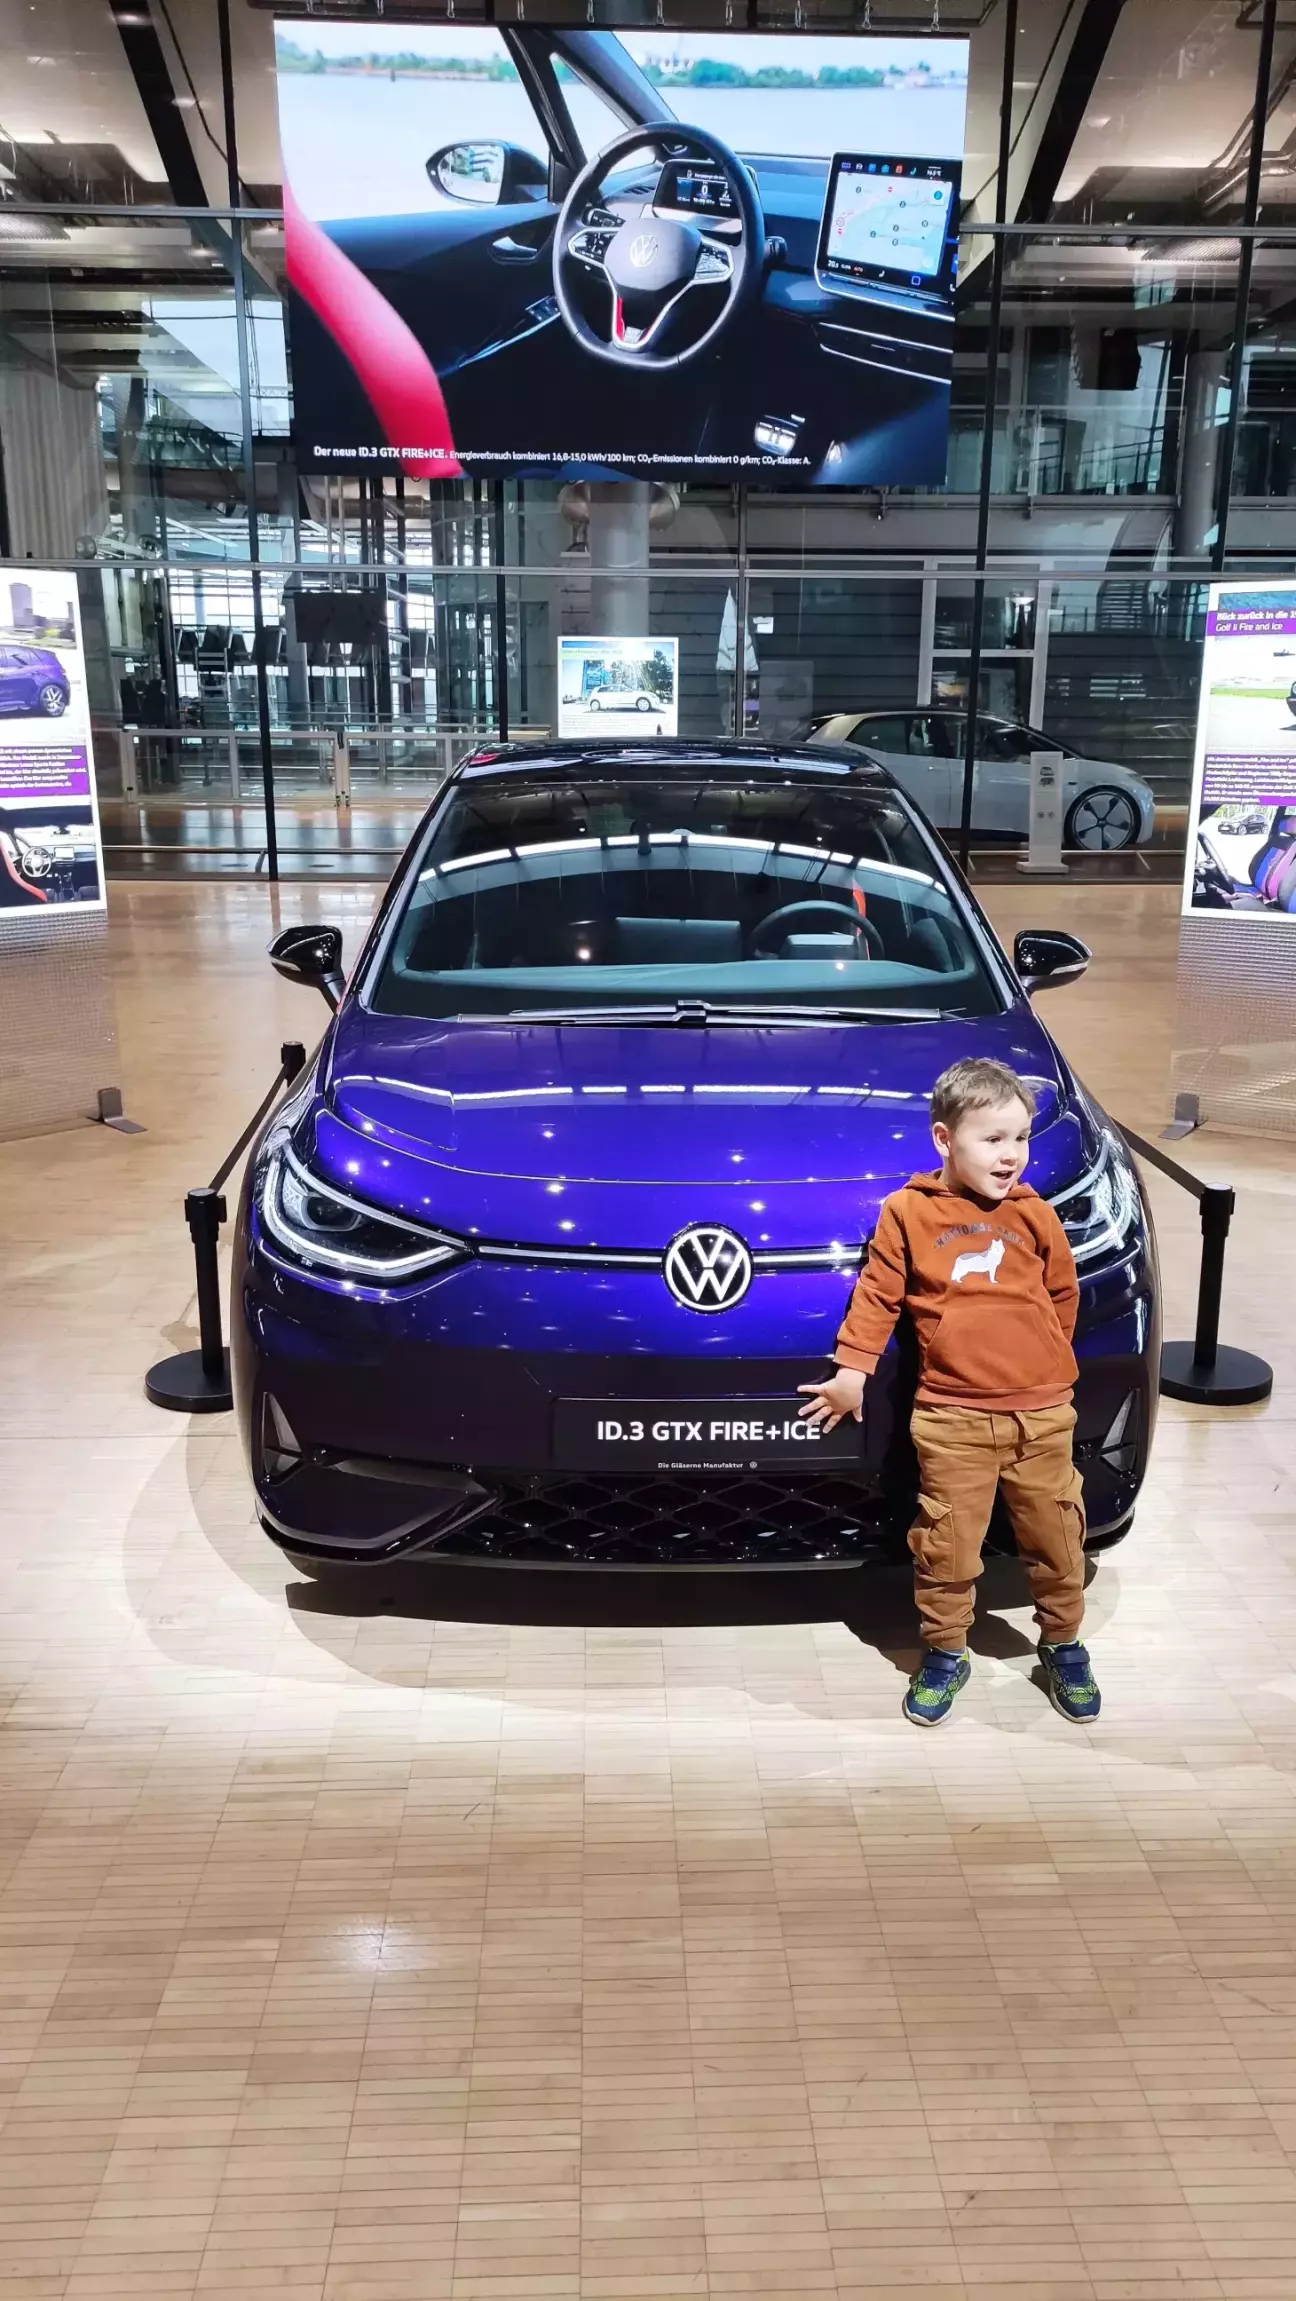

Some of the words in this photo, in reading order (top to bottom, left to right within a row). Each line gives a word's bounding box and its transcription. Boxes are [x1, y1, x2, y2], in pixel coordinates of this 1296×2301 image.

[314, 446, 331, 457] Der
[332, 447, 356, 457] neue
[358, 447, 378, 458] ID.3
[379, 447, 400, 458] GTX
[450, 451, 511, 461] Energieverbrauch
[513, 451, 551, 461] kombiniert
[694, 454, 732, 464] kombiniert
[1217, 612, 1236, 621] Blick
[1275, 610, 1288, 619] die
[1239, 623, 1254, 631] Fire
[1255, 622, 1270, 631] and
[597, 1420, 645, 1441] ID.3
[651, 1421, 703, 1441] GTX
[710, 1420, 821, 1441] FIRE+ICE
